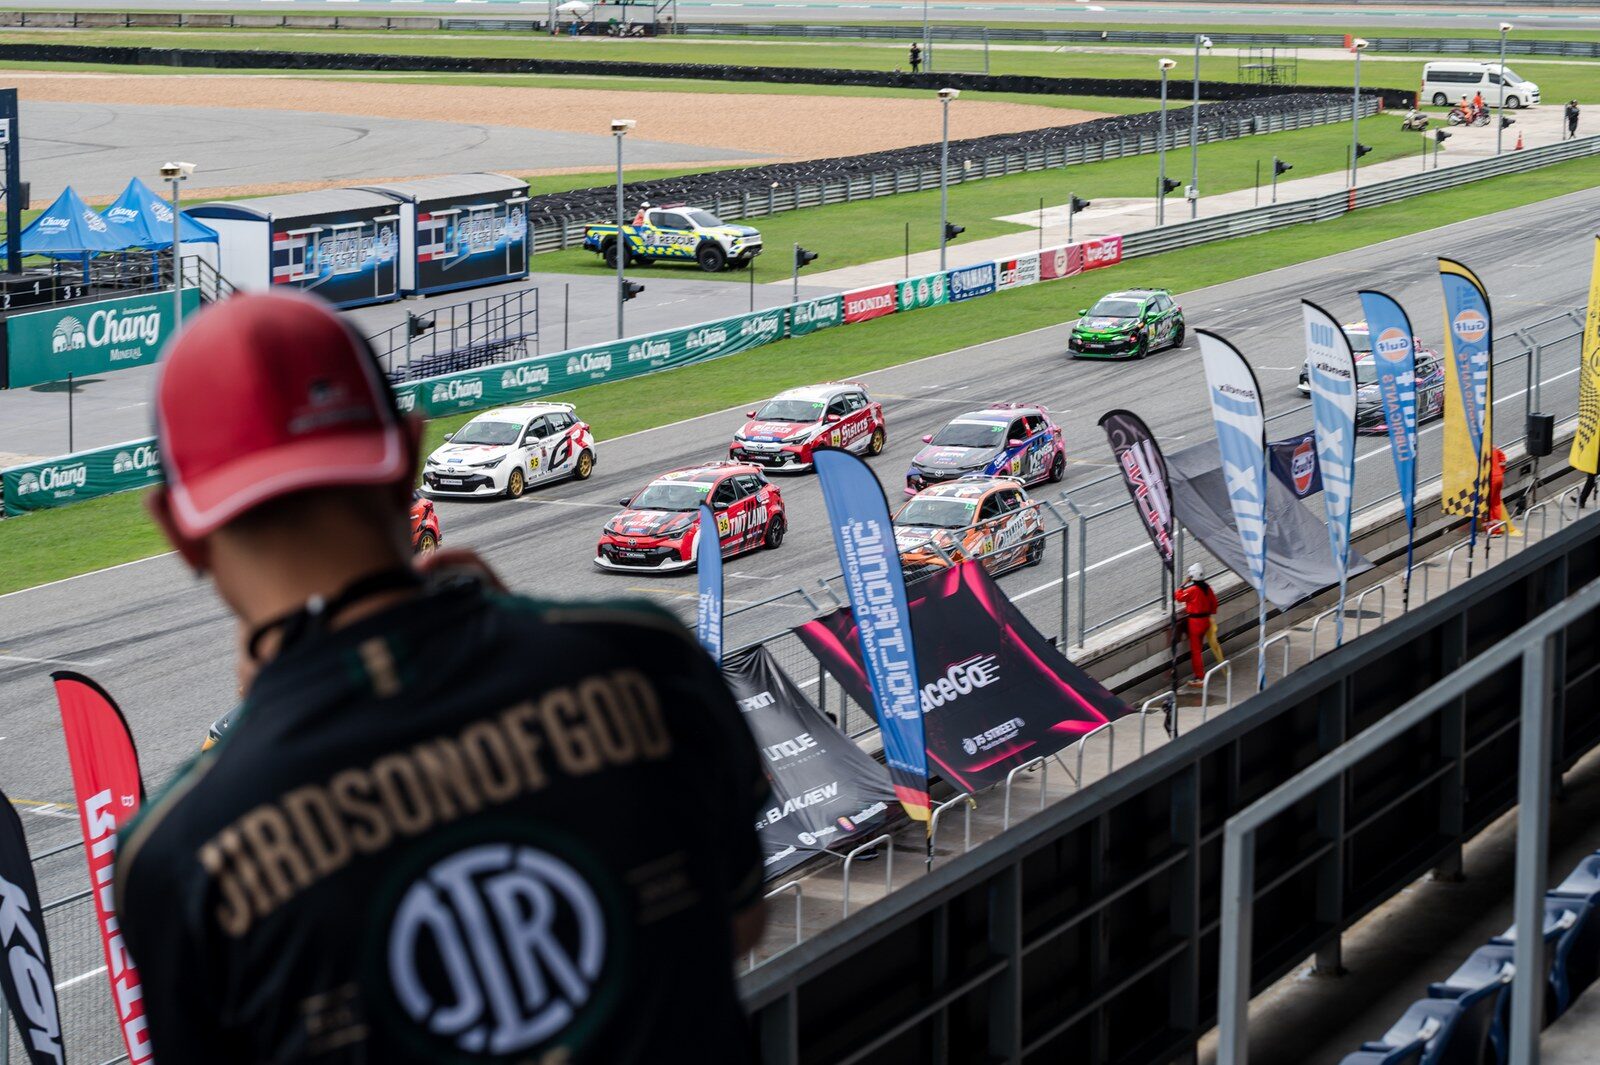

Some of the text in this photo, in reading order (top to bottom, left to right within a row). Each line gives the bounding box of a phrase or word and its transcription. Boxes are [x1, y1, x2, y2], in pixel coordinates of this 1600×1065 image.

[659, 232, 695, 246] RESCUE
[33, 281, 40, 295] 1
[962, 265, 993, 291] YAMAHA
[63, 286, 71, 300] 3
[847, 293, 892, 314] HONDA
[807, 298, 838, 320] Chang
[87, 309, 161, 348] Chang
[700, 327, 727, 346] Chang
[642, 338, 671, 359] Chang
[580, 351, 612, 373] Chang
[515, 364, 549, 387] Chang
[447, 379, 483, 400] Chang
[841, 417, 869, 442] Sisters
[548, 422, 589, 471] GR
[530, 457, 539, 469] 95
[40, 465, 87, 490] Chang
[720, 520, 729, 532] 36
[729, 506, 768, 536] TMT LAND
[919, 655, 1000, 713] aceGO
